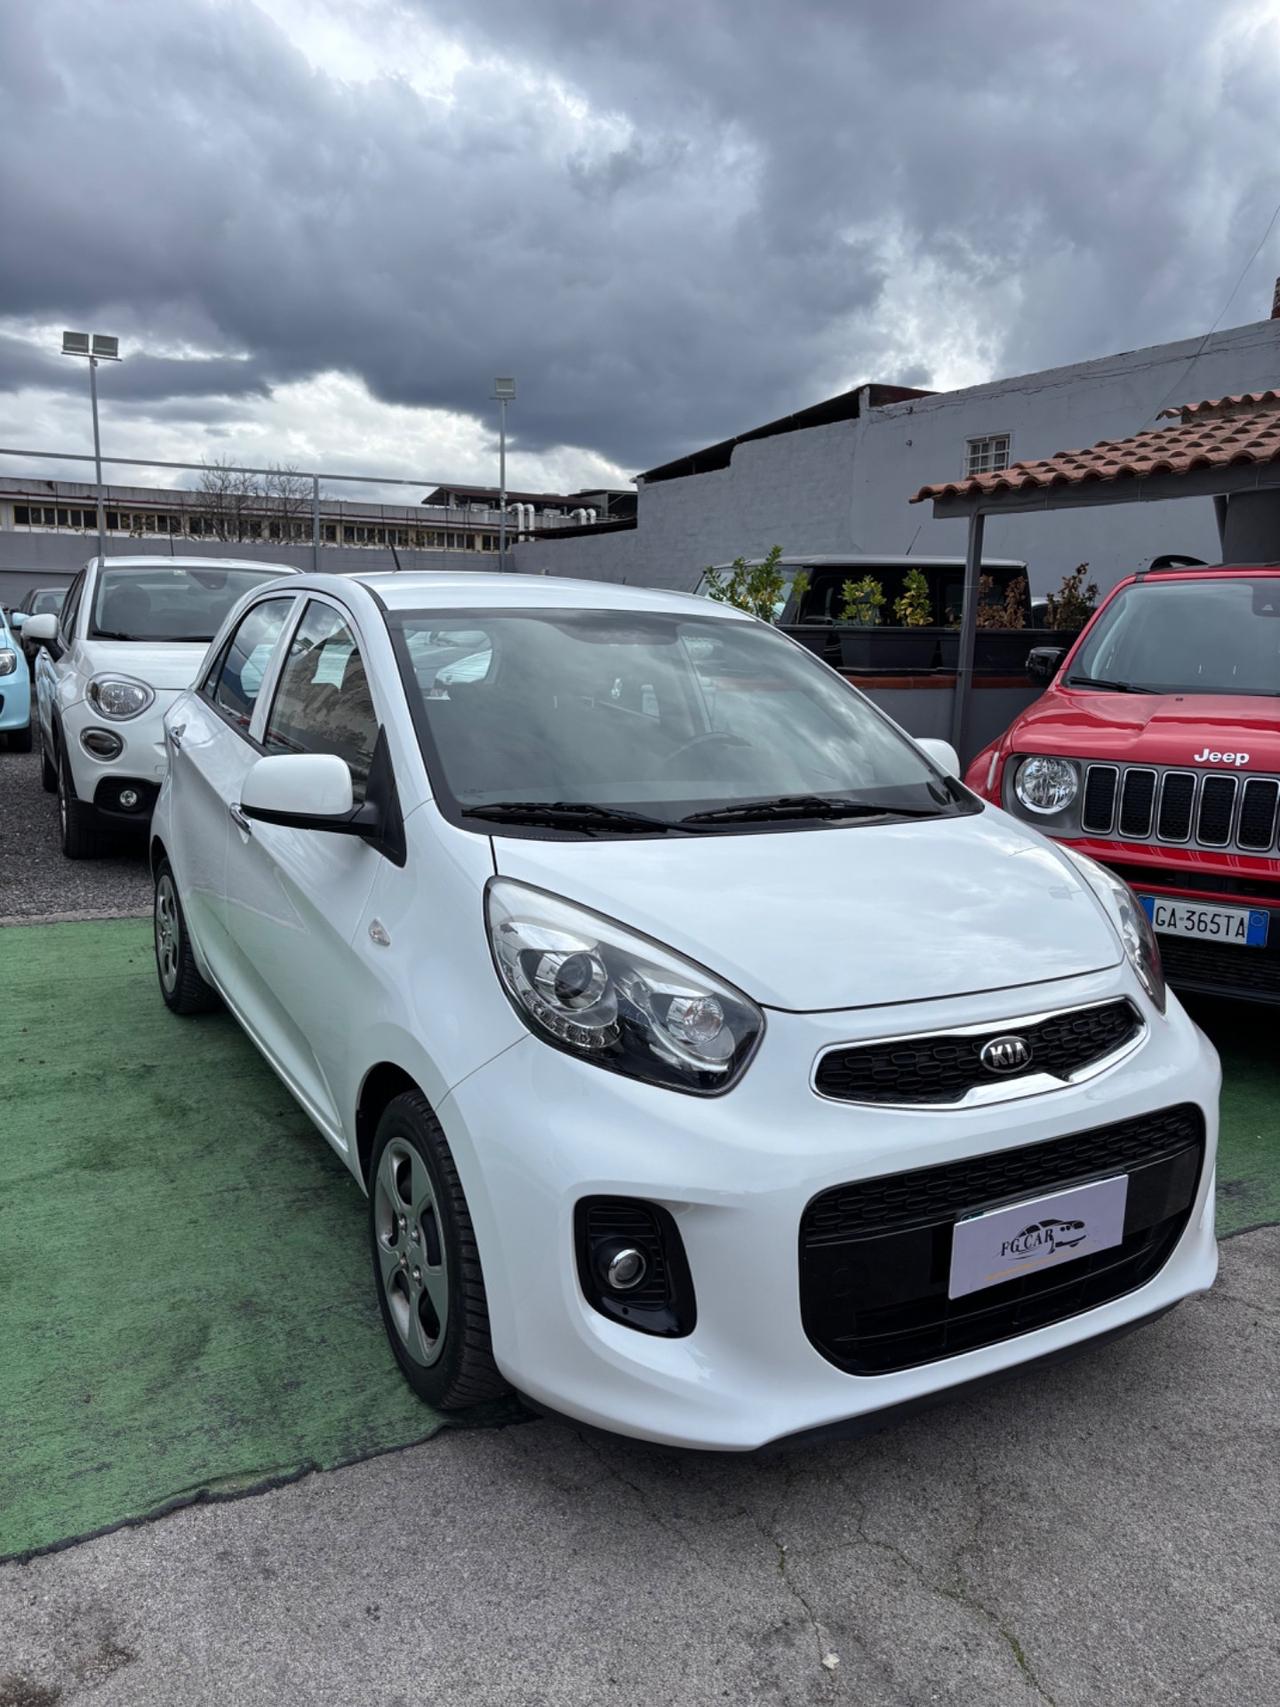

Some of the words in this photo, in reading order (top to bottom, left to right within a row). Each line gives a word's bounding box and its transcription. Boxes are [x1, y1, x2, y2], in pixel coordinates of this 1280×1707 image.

[1193, 748, 1250, 767] Jeep
[989, 1041, 1029, 1067] KIA
[1023, 1228, 1055, 1250] CAR
